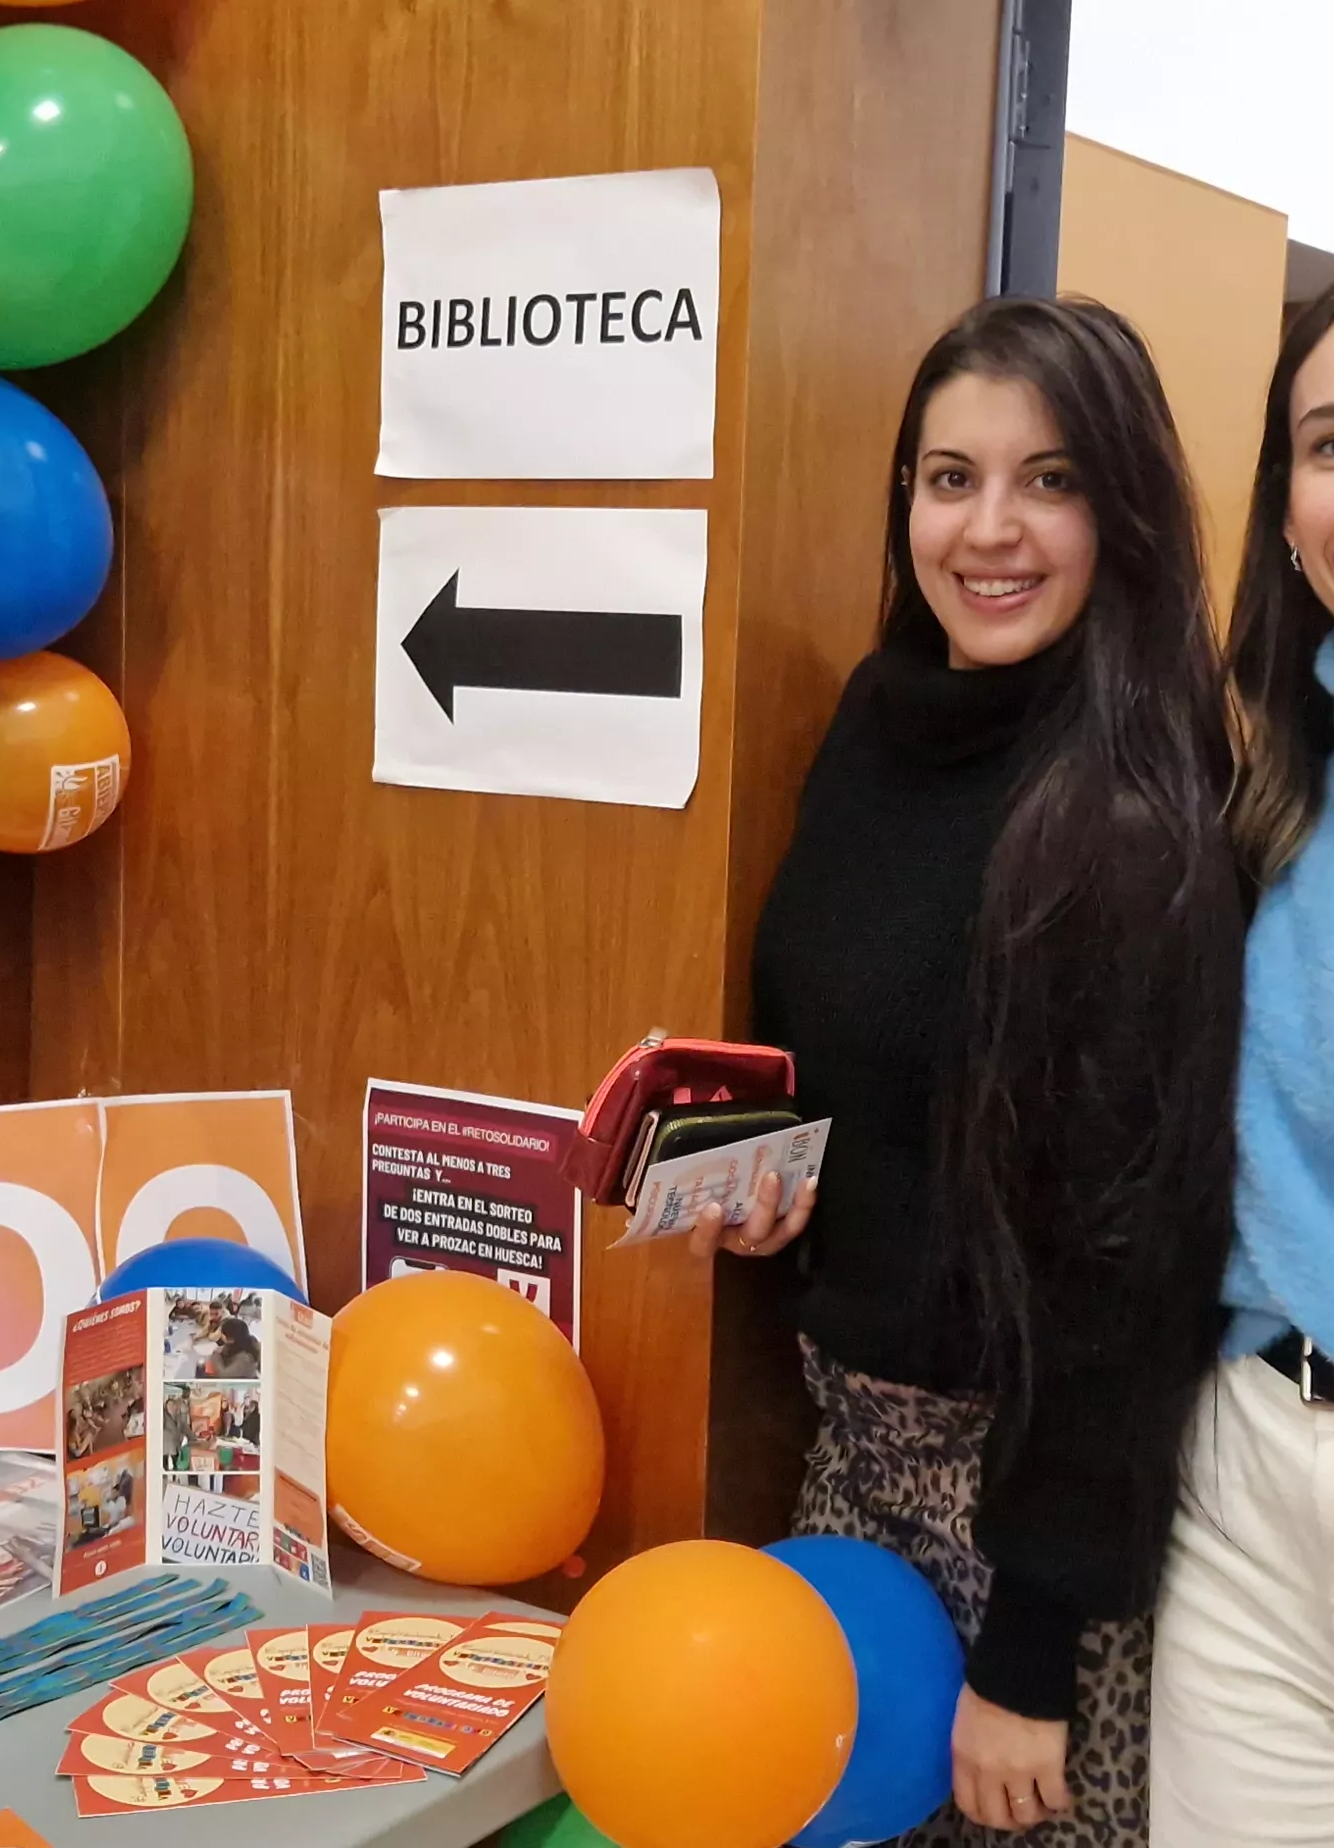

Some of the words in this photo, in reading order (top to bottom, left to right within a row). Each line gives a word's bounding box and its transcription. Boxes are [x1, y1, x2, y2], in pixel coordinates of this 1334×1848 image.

[398, 288, 703, 350] BIBLIOTECA
[374, 1111, 430, 1131] ¡PARTICIPA
[431, 1120, 447, 1134] EN
[448, 1122, 461, 1136] EL
[372, 1143, 425, 1164] CONTESTA
[426, 1151, 441, 1166] AL
[442, 1153, 476, 1173] MENOS
[477, 1160, 485, 1174] A
[486, 1162, 511, 1179] TRES
[372, 1158, 432, 1181] PREGUNTAS
[412, 1187, 456, 1208] ¡ENTRA
[457, 1195, 473, 1212] EN
[474, 1198, 488, 1215] EL
[489, 1202, 533, 1224] SORTEO
[383, 1203, 399, 1220] DE
[399, 1206, 423, 1224] DOS
[424, 1211, 485, 1236] ENTRADAS
[485, 1222, 528, 1245] DOBLES
[529, 1232, 562, 1253] PARA
[397, 1227, 420, 1245] VER
[420, 1231, 430, 1247] A
[431, 1233, 477, 1255] PROZAC
[478, 1242, 493, 1259] EN
[494, 1246, 543, 1270] HUESCA!
[174, 1494, 260, 1529] HAZTE
[403, 1690, 510, 1718] VOLUNTARIADO
[414, 1683, 493, 1704] PROGRAMA
[492, 1698, 516, 1708] DE
